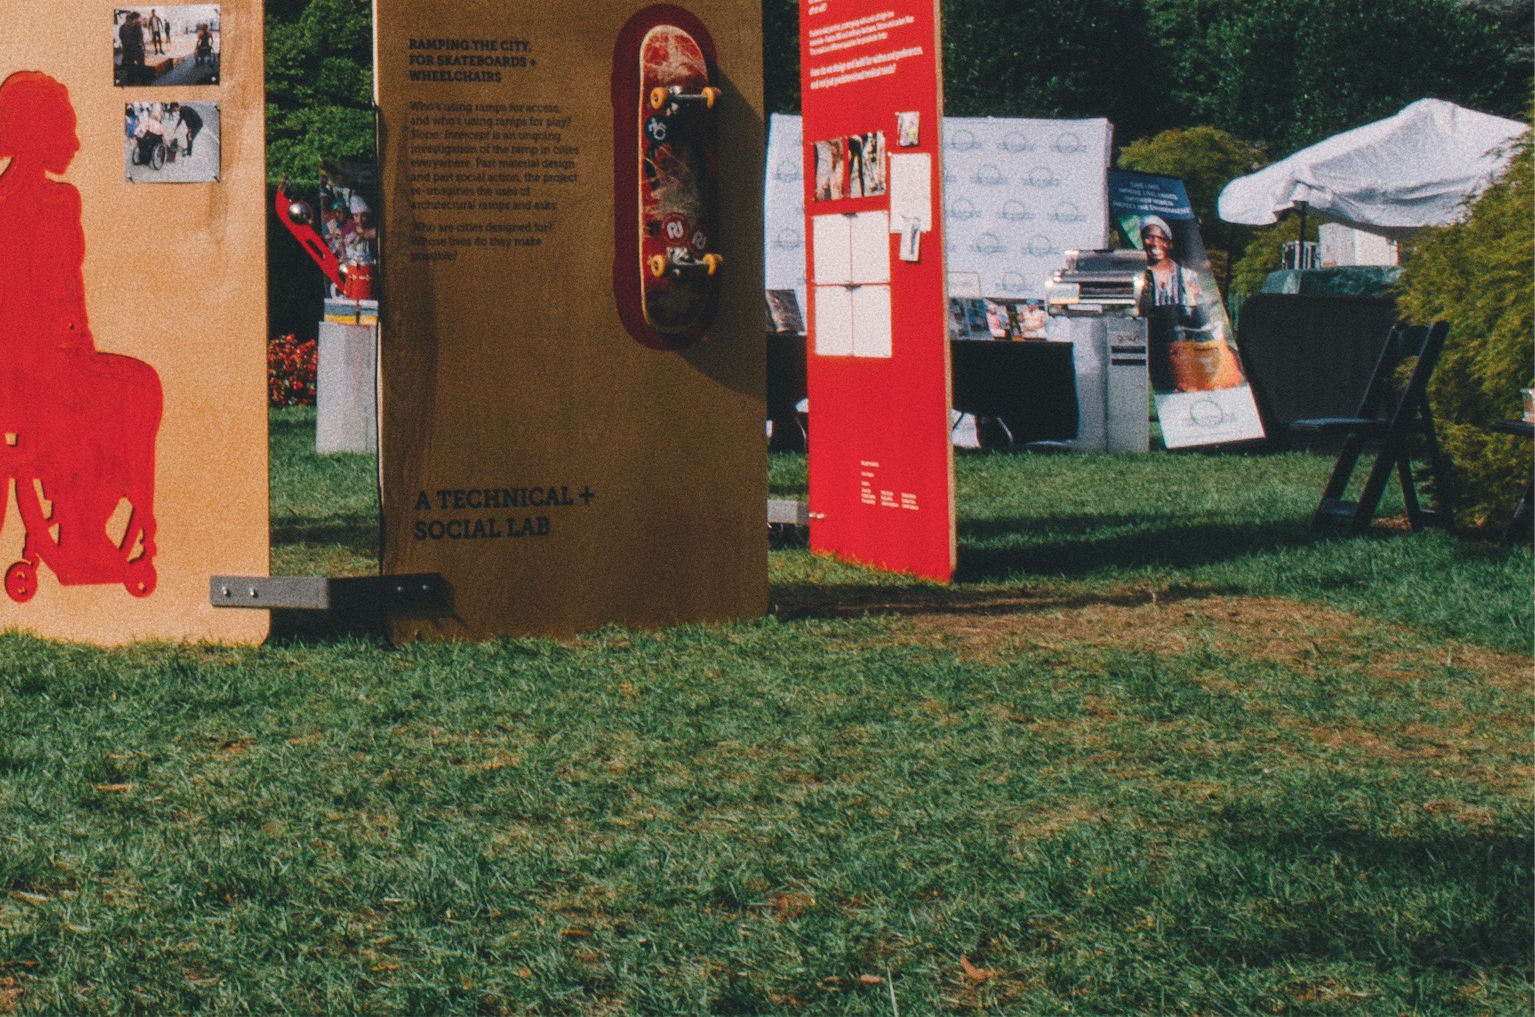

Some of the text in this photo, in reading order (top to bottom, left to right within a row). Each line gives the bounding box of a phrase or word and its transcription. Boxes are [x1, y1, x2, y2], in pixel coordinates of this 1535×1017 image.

[409, 38, 470, 51] RAMPING
[471, 39, 498, 52] THE
[409, 54, 434, 66] FOR
[437, 55, 527, 67] SKATEBOARDS
[409, 69, 502, 82] WHEELCHAIRS
[410, 101, 441, 112] Who's
[444, 103, 472, 114] using
[475, 103, 506, 114] ramps
[509, 103, 524, 112] for
[410, 116, 430, 126] and
[433, 116, 462, 126] who's
[464, 117, 493, 128] using
[495, 118, 527, 128] ramps
[529, 116, 543, 127] for
[492, 131, 501, 140] is
[503, 132, 516, 141] an
[519, 131, 561, 143] ongoing
[410, 144, 477, 156] investigation
[479, 145, 490, 154] of
[492, 145, 508, 154] the
[511, 147, 538, 157] ramp
[541, 146, 551, 155] in
[476, 157, 496, 168] Part
[499, 158, 540, 169] material
[541, 158, 575, 170] design
[410, 172, 430, 182] and
[433, 173, 454, 184] part
[456, 172, 485, 182] social
[524, 172, 540, 182] the
[477, 186, 492, 196] the
[520, 186, 530, 196] of
[478, 201, 510, 212] ramps
[513, 200, 531, 211] and
[412, 222, 435, 232] Who
[438, 223, 454, 232] are
[456, 223, 483, 232] cities
[485, 222, 531, 234] designed
[475, 237, 487, 246] do
[489, 237, 512, 248] they
[514, 237, 542, 247] make
[414, 490, 432, 511] A
[436, 486, 573, 510] TECHNICAL
[414, 516, 551, 541] SOCIAL LAB
